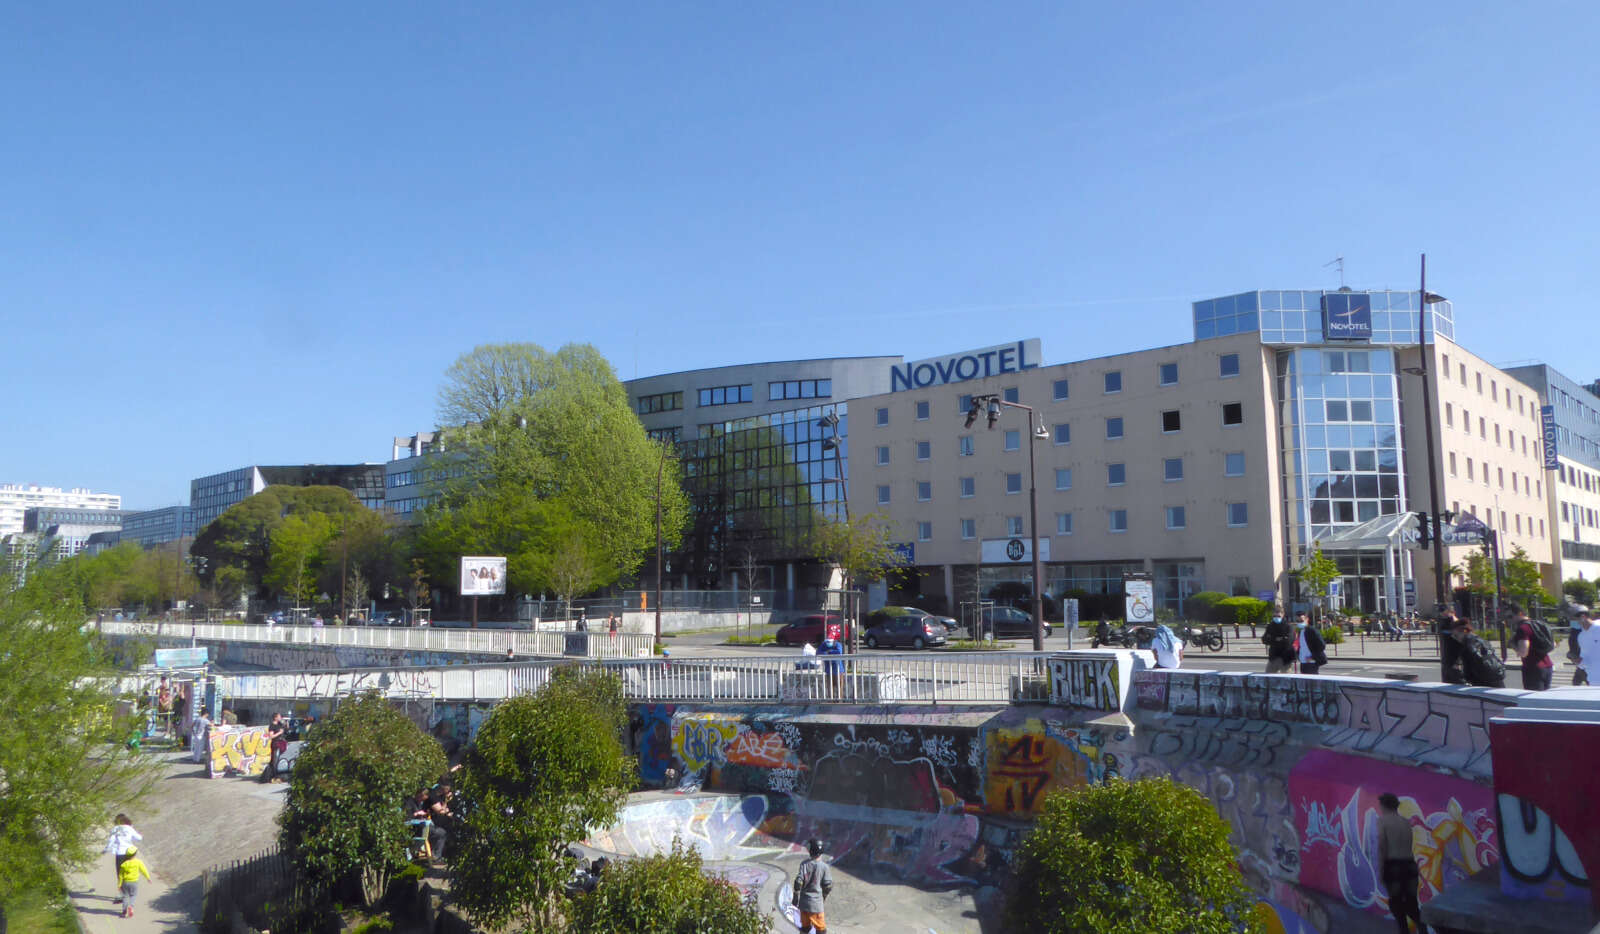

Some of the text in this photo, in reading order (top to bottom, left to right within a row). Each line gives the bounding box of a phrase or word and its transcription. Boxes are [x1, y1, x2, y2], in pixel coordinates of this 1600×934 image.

[1330, 322, 1370, 330] NOVOTEL
[891, 340, 1038, 393] NOVOTEL
[1543, 409, 1556, 467] NOVOTEL
